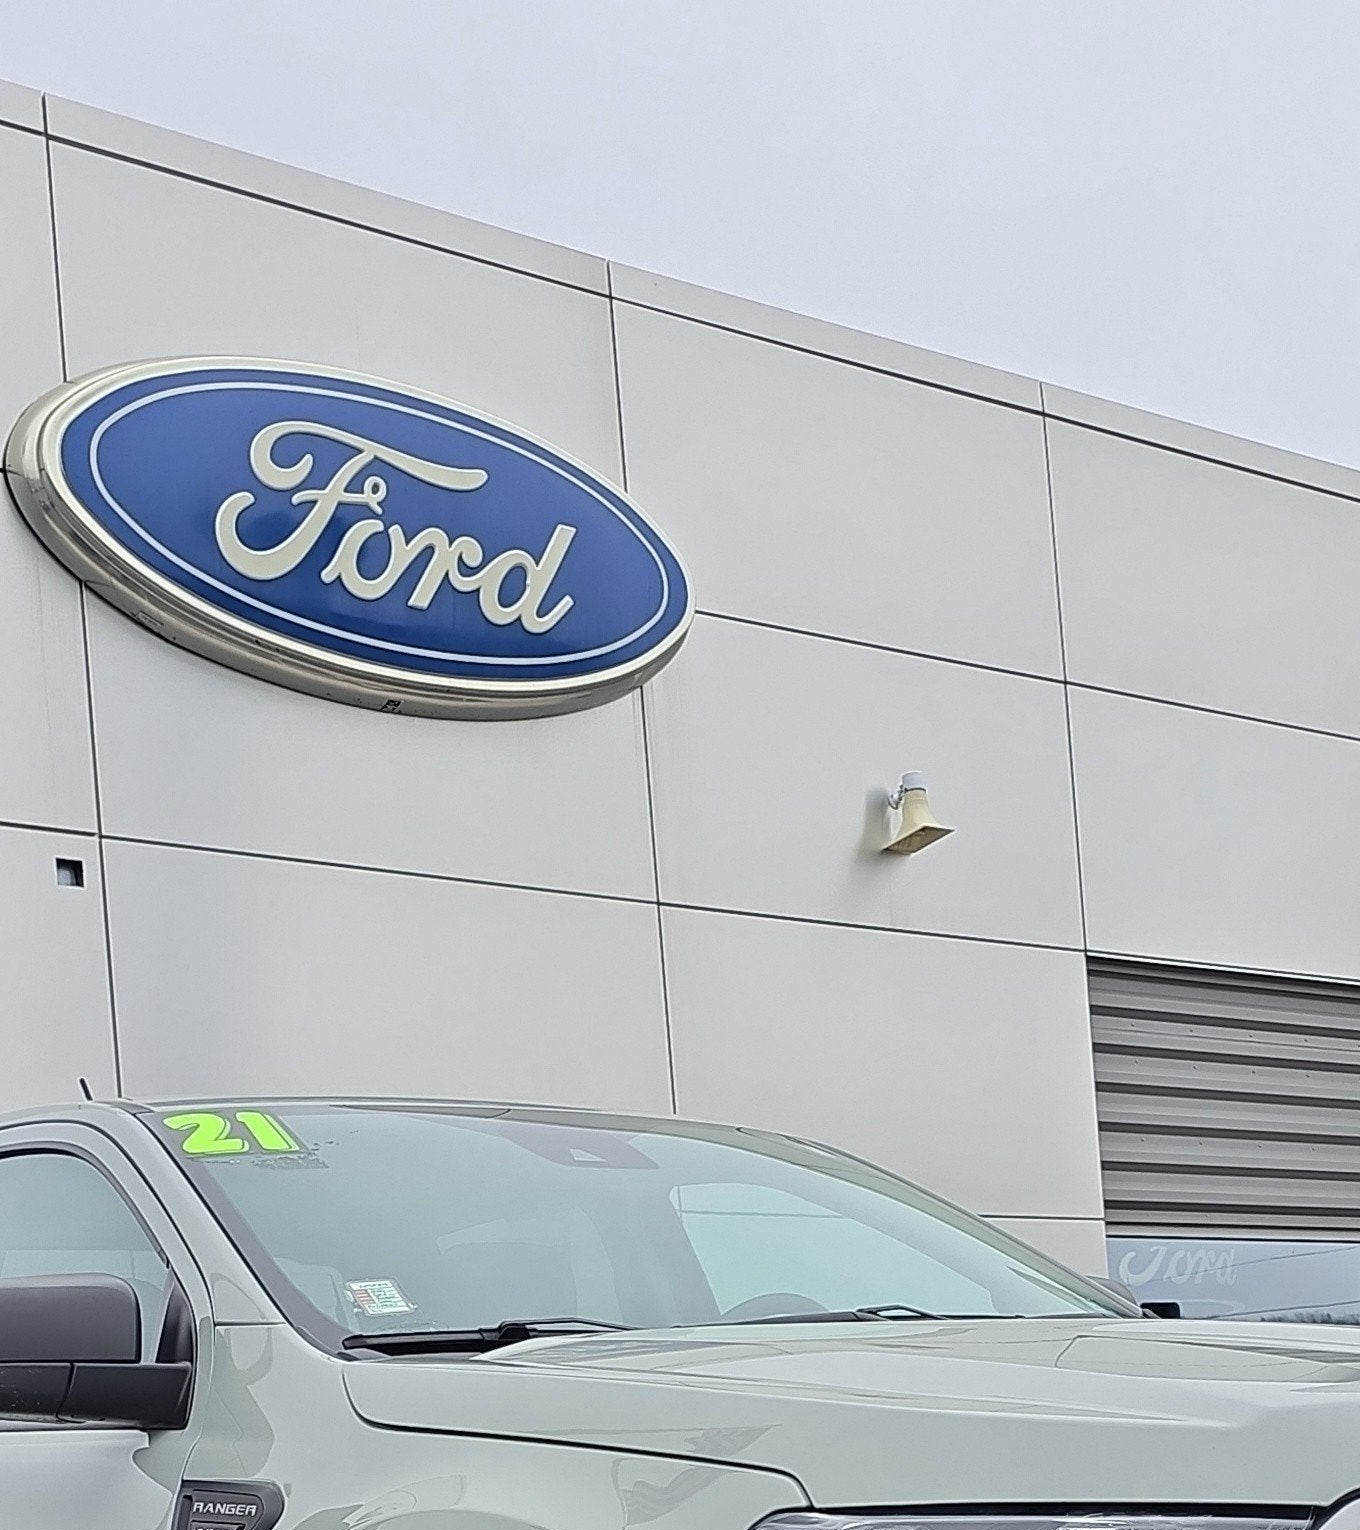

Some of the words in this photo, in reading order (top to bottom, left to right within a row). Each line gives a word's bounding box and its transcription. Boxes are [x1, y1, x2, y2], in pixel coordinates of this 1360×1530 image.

[214, 419, 578, 635] Ford
[162, 1111, 301, 1156] 21
[192, 1501, 258, 1517] RANGER
